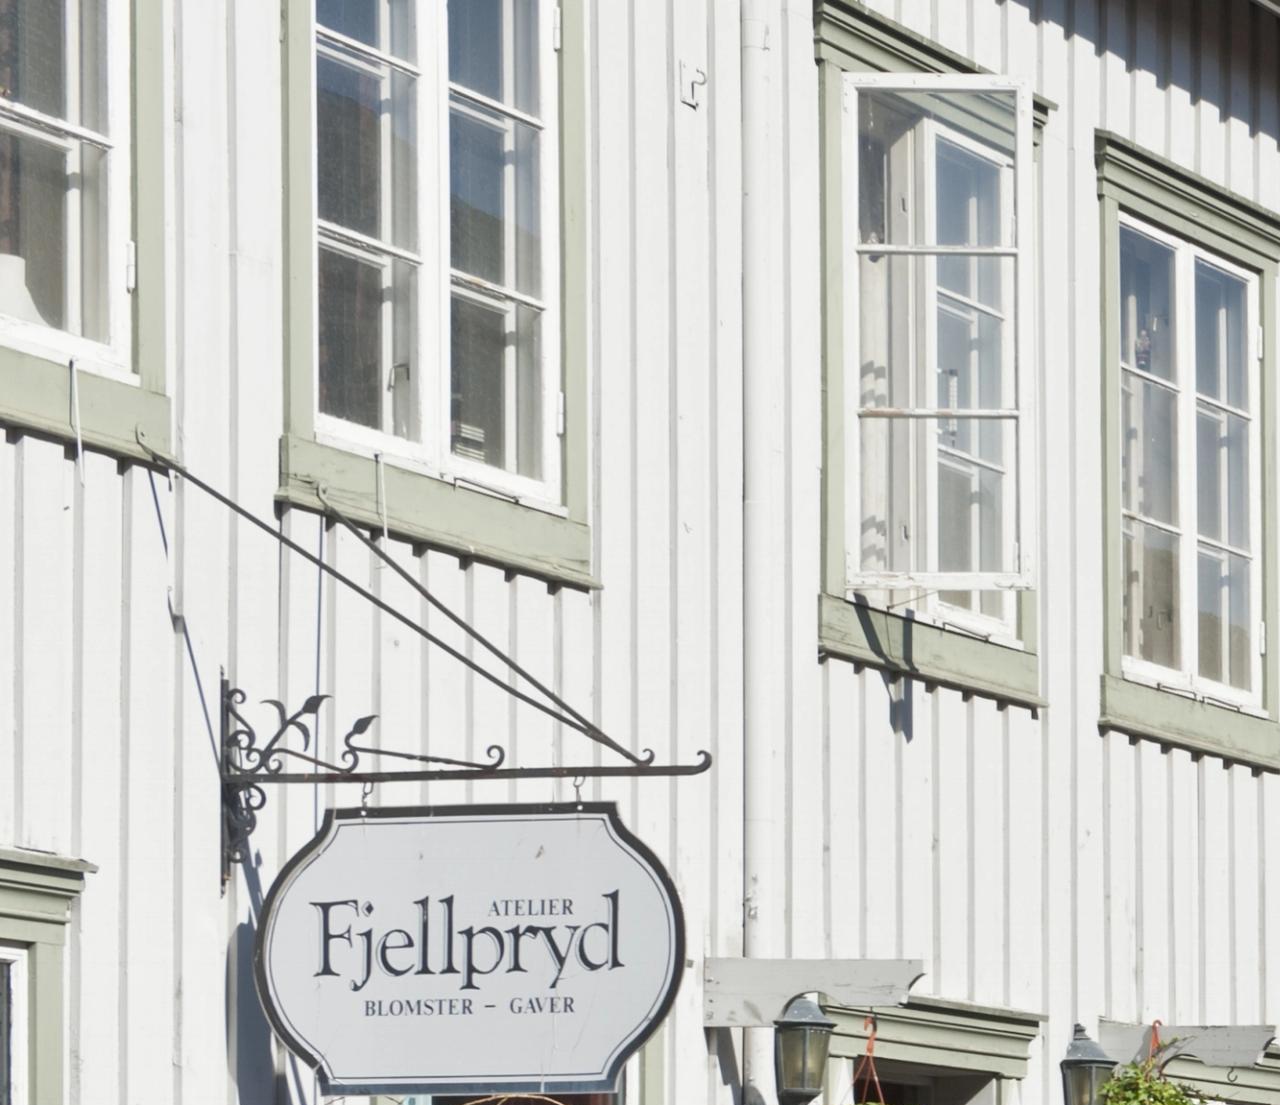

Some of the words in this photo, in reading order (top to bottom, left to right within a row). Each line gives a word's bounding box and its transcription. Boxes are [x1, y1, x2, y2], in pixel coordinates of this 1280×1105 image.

[488, 899, 574, 917] ATELIER
[309, 889, 625, 991] Fjellpryd
[364, 998, 474, 1017] BLOMSTER
[509, 996, 575, 1014] GAVER
